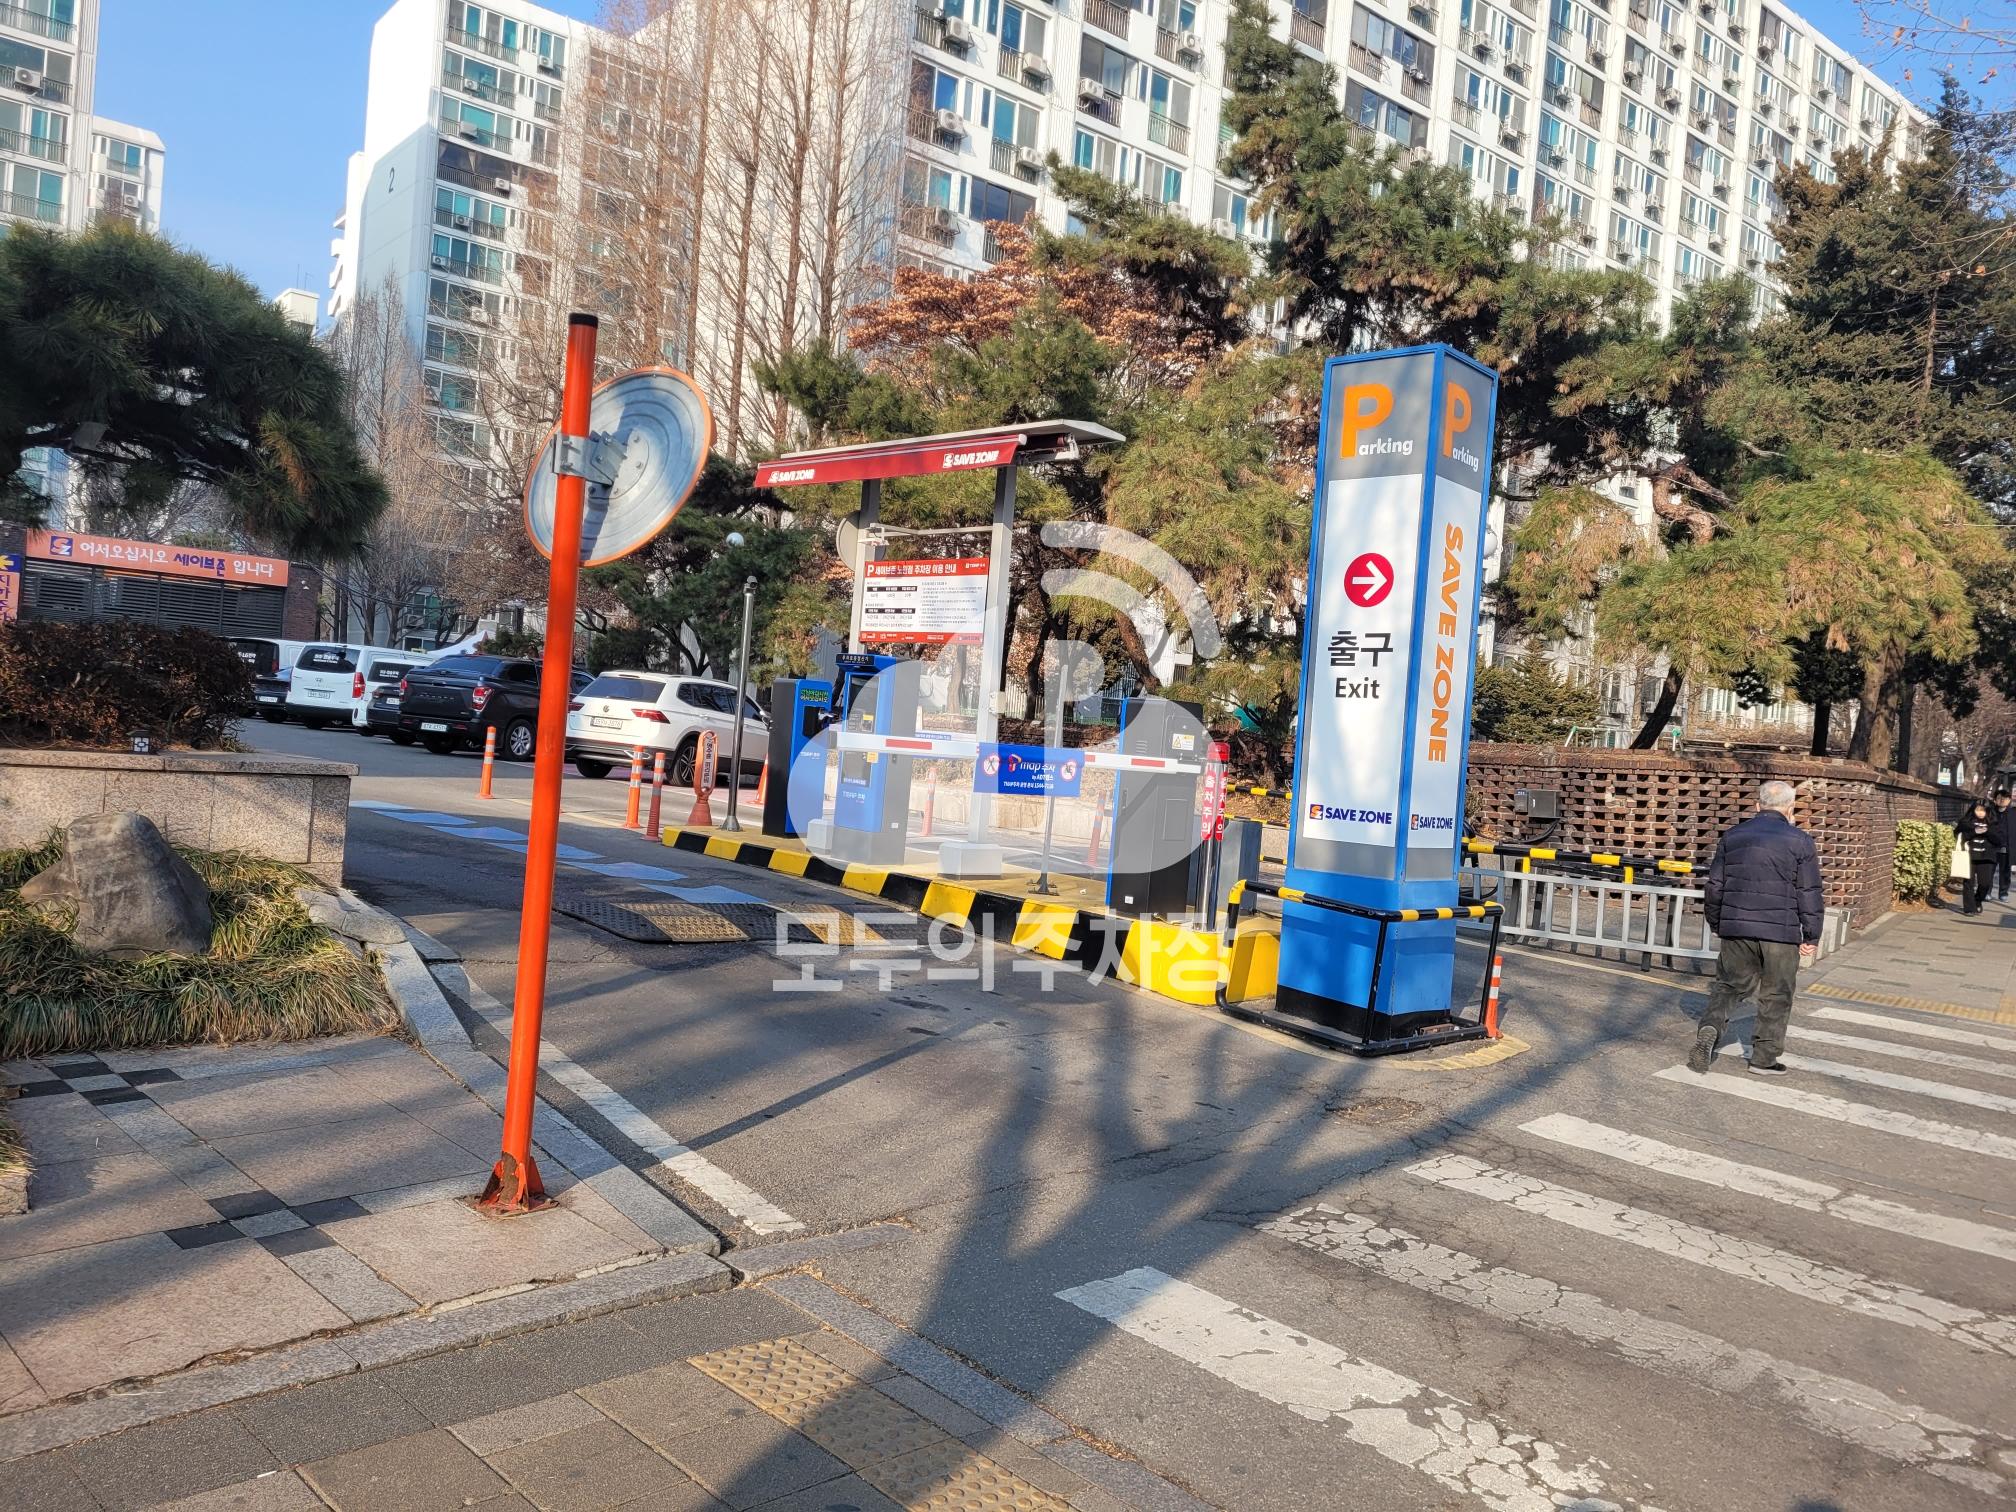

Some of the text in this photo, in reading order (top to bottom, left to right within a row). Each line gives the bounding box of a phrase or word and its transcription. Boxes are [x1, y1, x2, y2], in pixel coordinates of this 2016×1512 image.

[1340, 383, 1413, 459] Parking
[1443, 381, 1479, 472] Parking
[79, 542, 274, 578] 어서오십시오 세이브존 입니다
[914, 563, 931, 574] 주차장
[1327, 630, 1394, 667] 출구
[1428, 522, 1464, 763] SAVE ZONE
[1335, 677, 1380, 699] Exit
[1202, 775, 1215, 834] 출차주의
[1325, 807, 1357, 822] SAVE
[1358, 809, 1393, 825] ZONE
[1419, 816, 1436, 829] SAVE
[1436, 816, 1453, 830] ZONE
